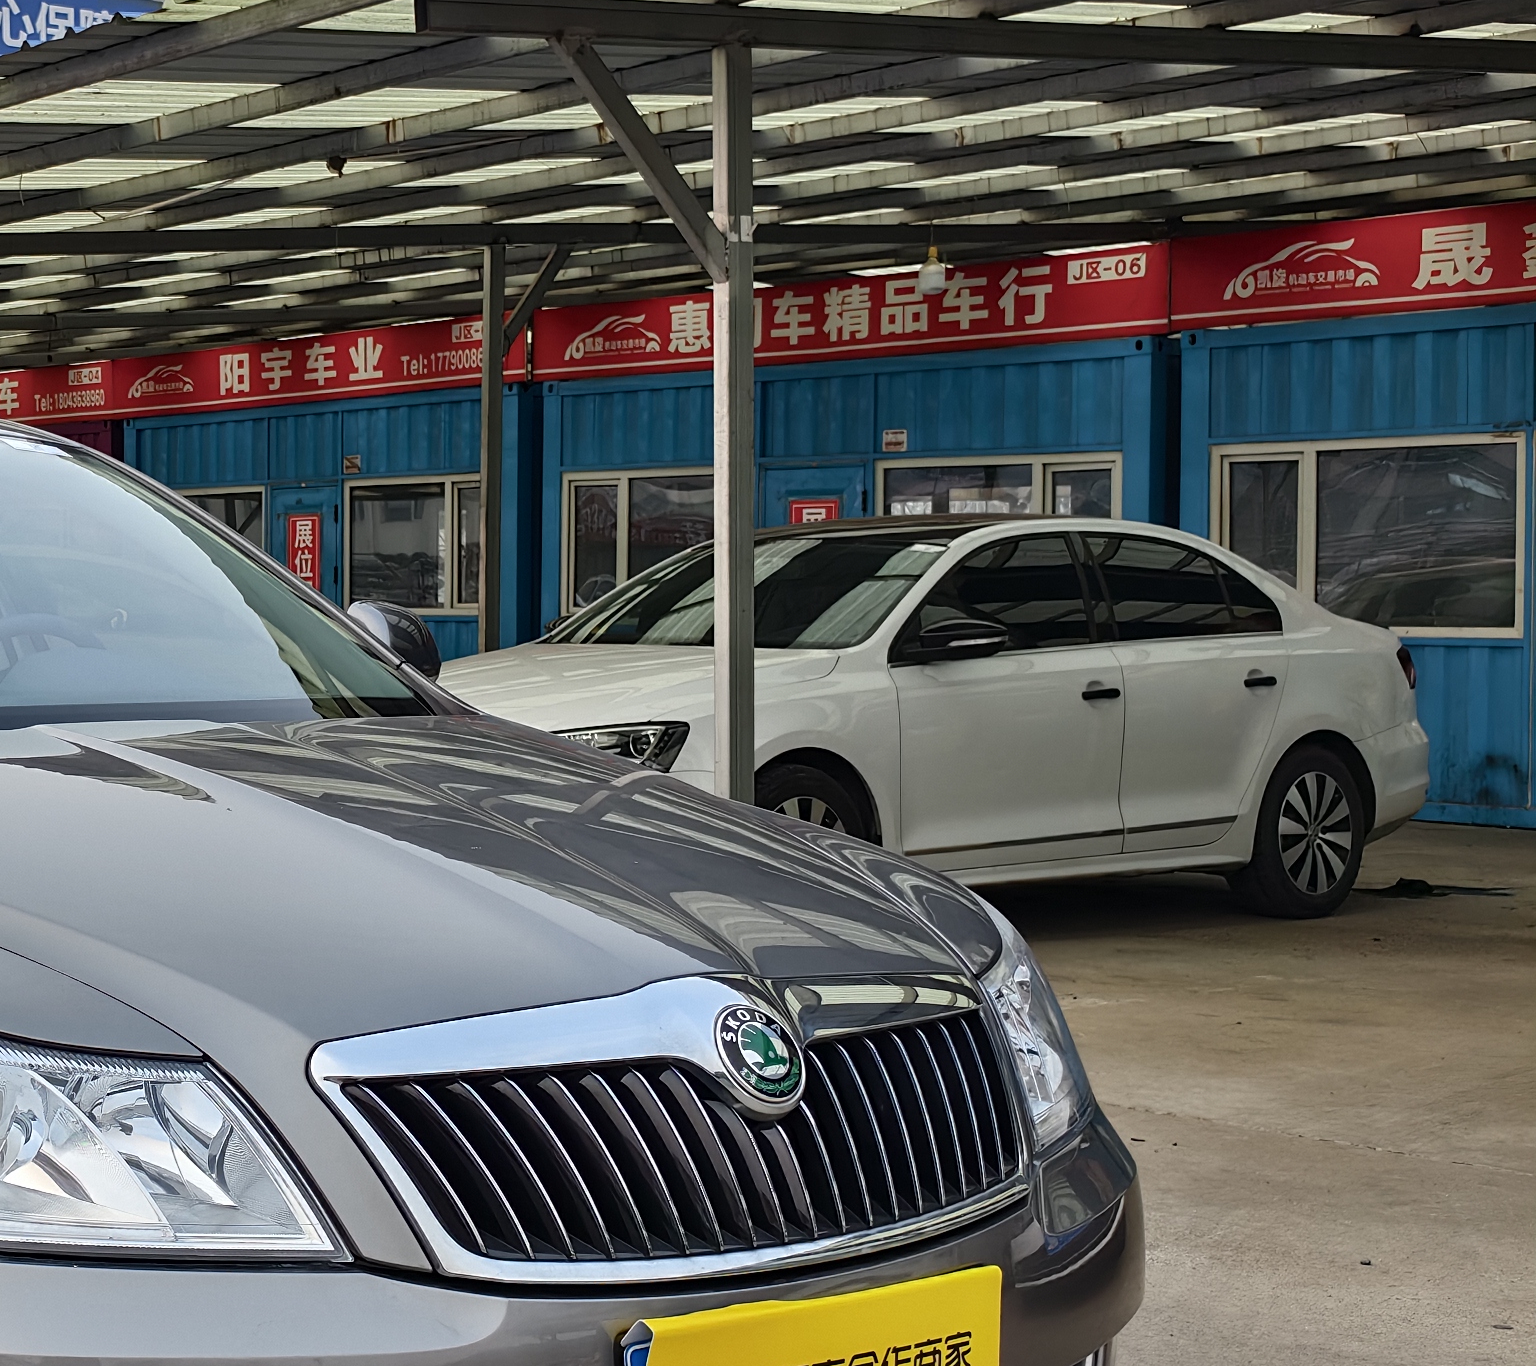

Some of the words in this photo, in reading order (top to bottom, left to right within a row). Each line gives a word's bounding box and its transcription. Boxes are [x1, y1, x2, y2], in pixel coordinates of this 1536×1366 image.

[1072, 257, 1143, 282] J区-06
[667, 265, 1053, 354] 惠车精品车行
[454, 324, 483, 341] J区-
[219, 336, 384, 396] 阳宇车业
